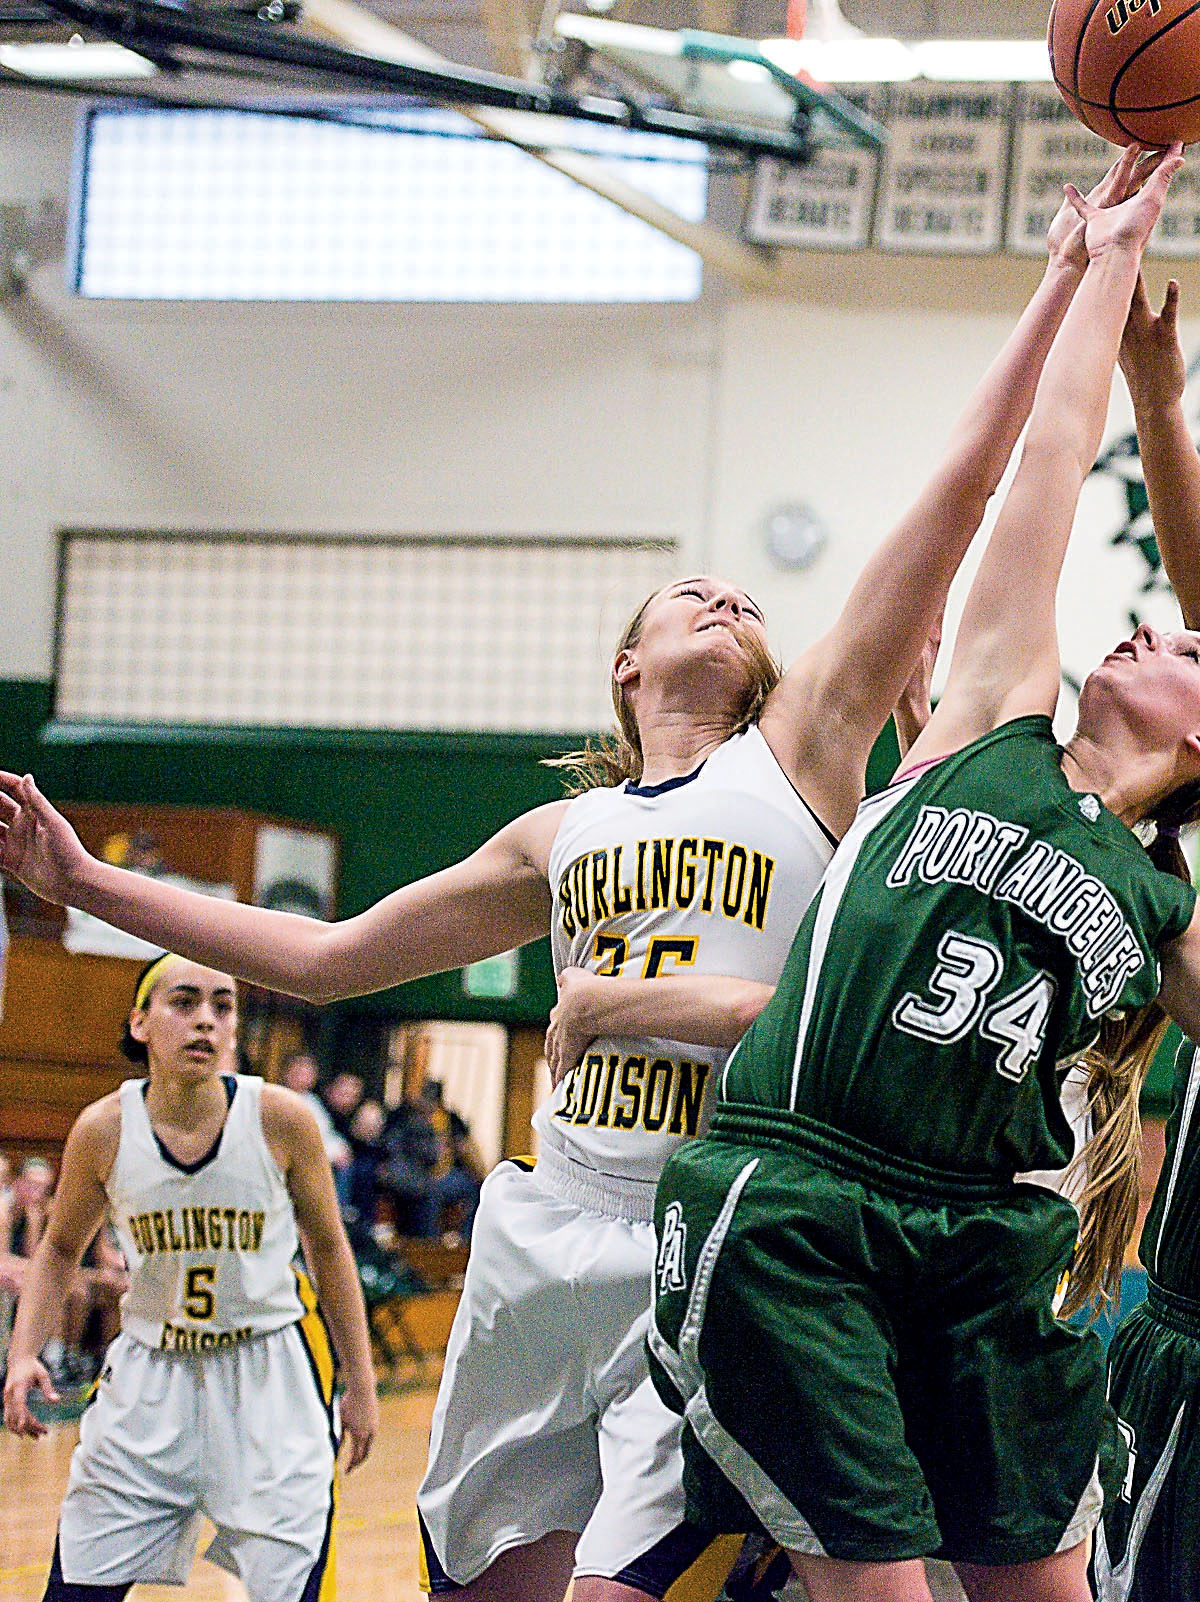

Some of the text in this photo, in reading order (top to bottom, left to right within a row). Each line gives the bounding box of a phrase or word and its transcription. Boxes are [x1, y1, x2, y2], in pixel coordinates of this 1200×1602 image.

[886, 805, 1145, 1019] PORT ANGELES
[892, 929, 1058, 1083] 34
[184, 1265, 217, 1323] 5
